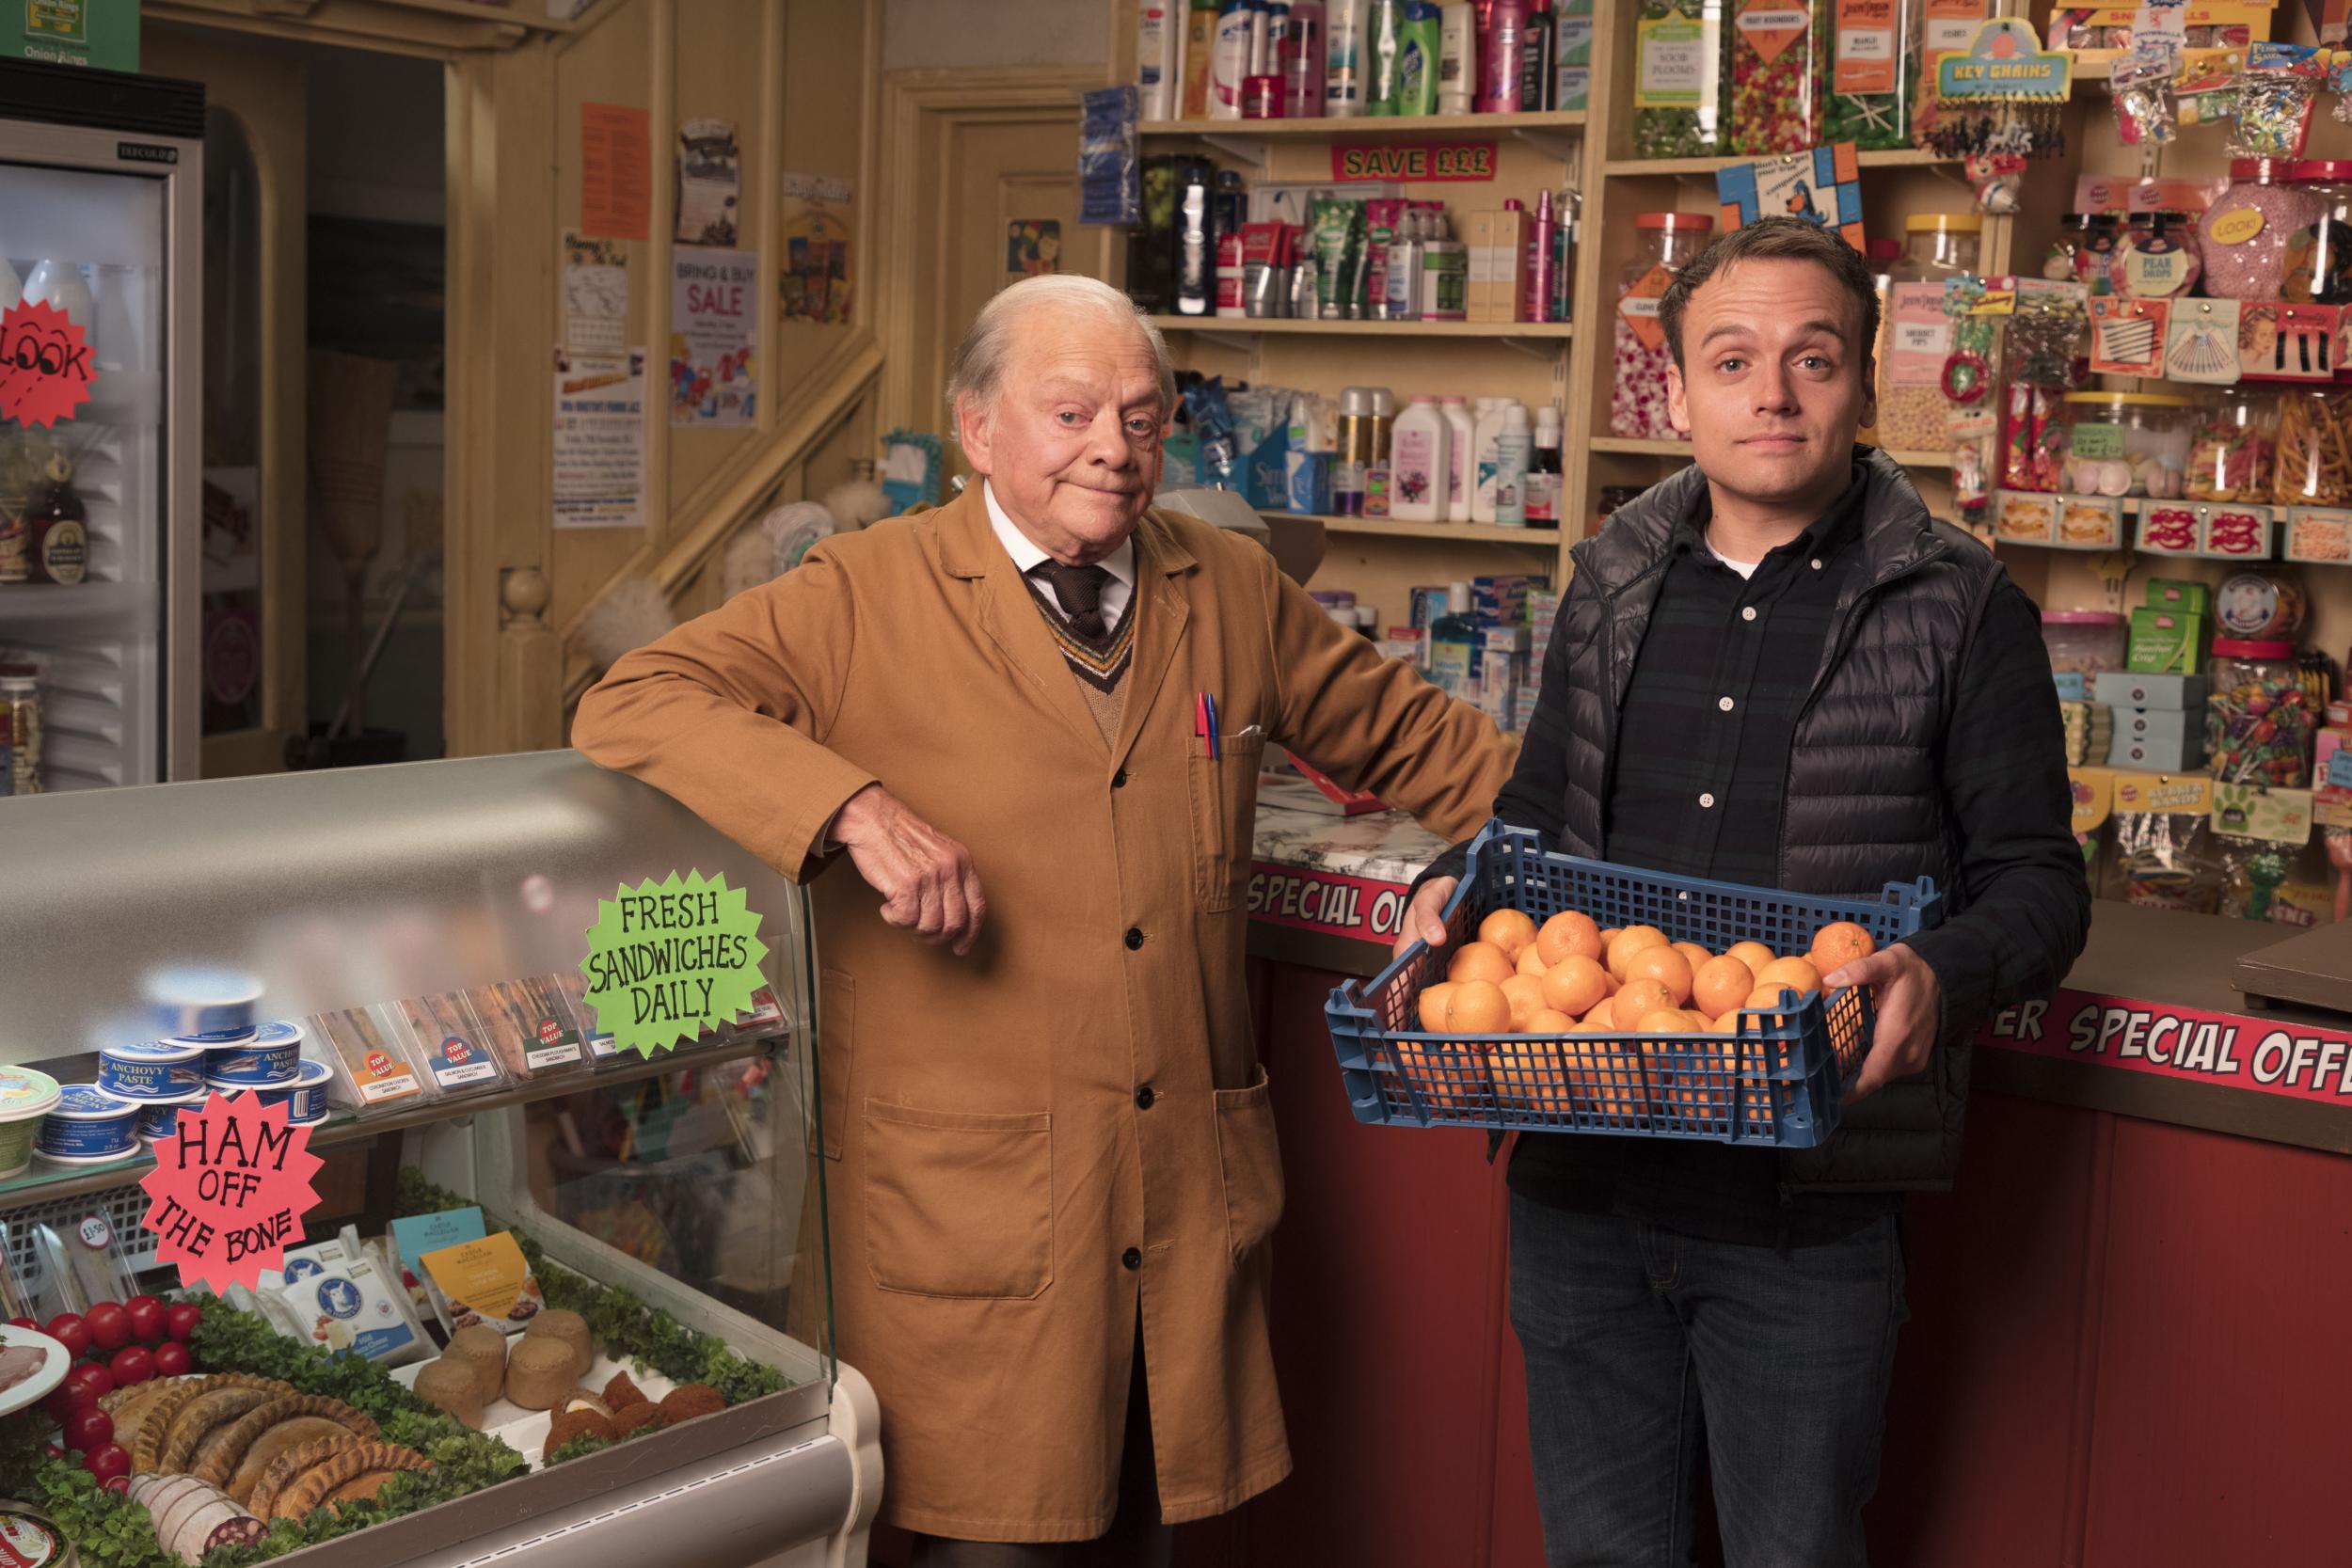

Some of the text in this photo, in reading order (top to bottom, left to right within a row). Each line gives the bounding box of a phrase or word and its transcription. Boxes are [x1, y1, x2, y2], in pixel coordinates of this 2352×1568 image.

[24, 46, 56, 60] Onion
[1953, 64, 2052, 80] KEY CHAINS
[1345, 148, 1491, 176] SAVE £££
[2217, 217, 2258, 237] LOOK!
[676, 262, 715, 280] BRING
[720, 266, 729, 282] &
[2142, 257, 2172, 268] PEAR
[688, 284, 743, 315] SALE
[0, 325, 87, 381] LOOK
[1248, 872, 1362, 927] SPECIAL
[620, 891, 719, 933] FRESH
[589, 933, 748, 993] SANDWICHES
[631, 977, 714, 1024] DAILY
[540, 1029, 564, 1045] VALUE
[542, 1022, 557, 1033] TOP
[447, 1042, 463, 1053] TOP
[2068, 1004, 2241, 1074] SPECIAL
[371, 1055, 386, 1067] TOP
[447, 1049, 472, 1064] VALUE
[111, 1062, 166, 1075] ANCHOVY
[372, 1062, 395, 1077] VALUE
[119, 1074, 153, 1085] PASTE
[178, 1116, 296, 1171] HAM
[198, 1169, 262, 1208] OFF
[155, 1195, 215, 1259] THE
[224, 1207, 293, 1264] BONE
